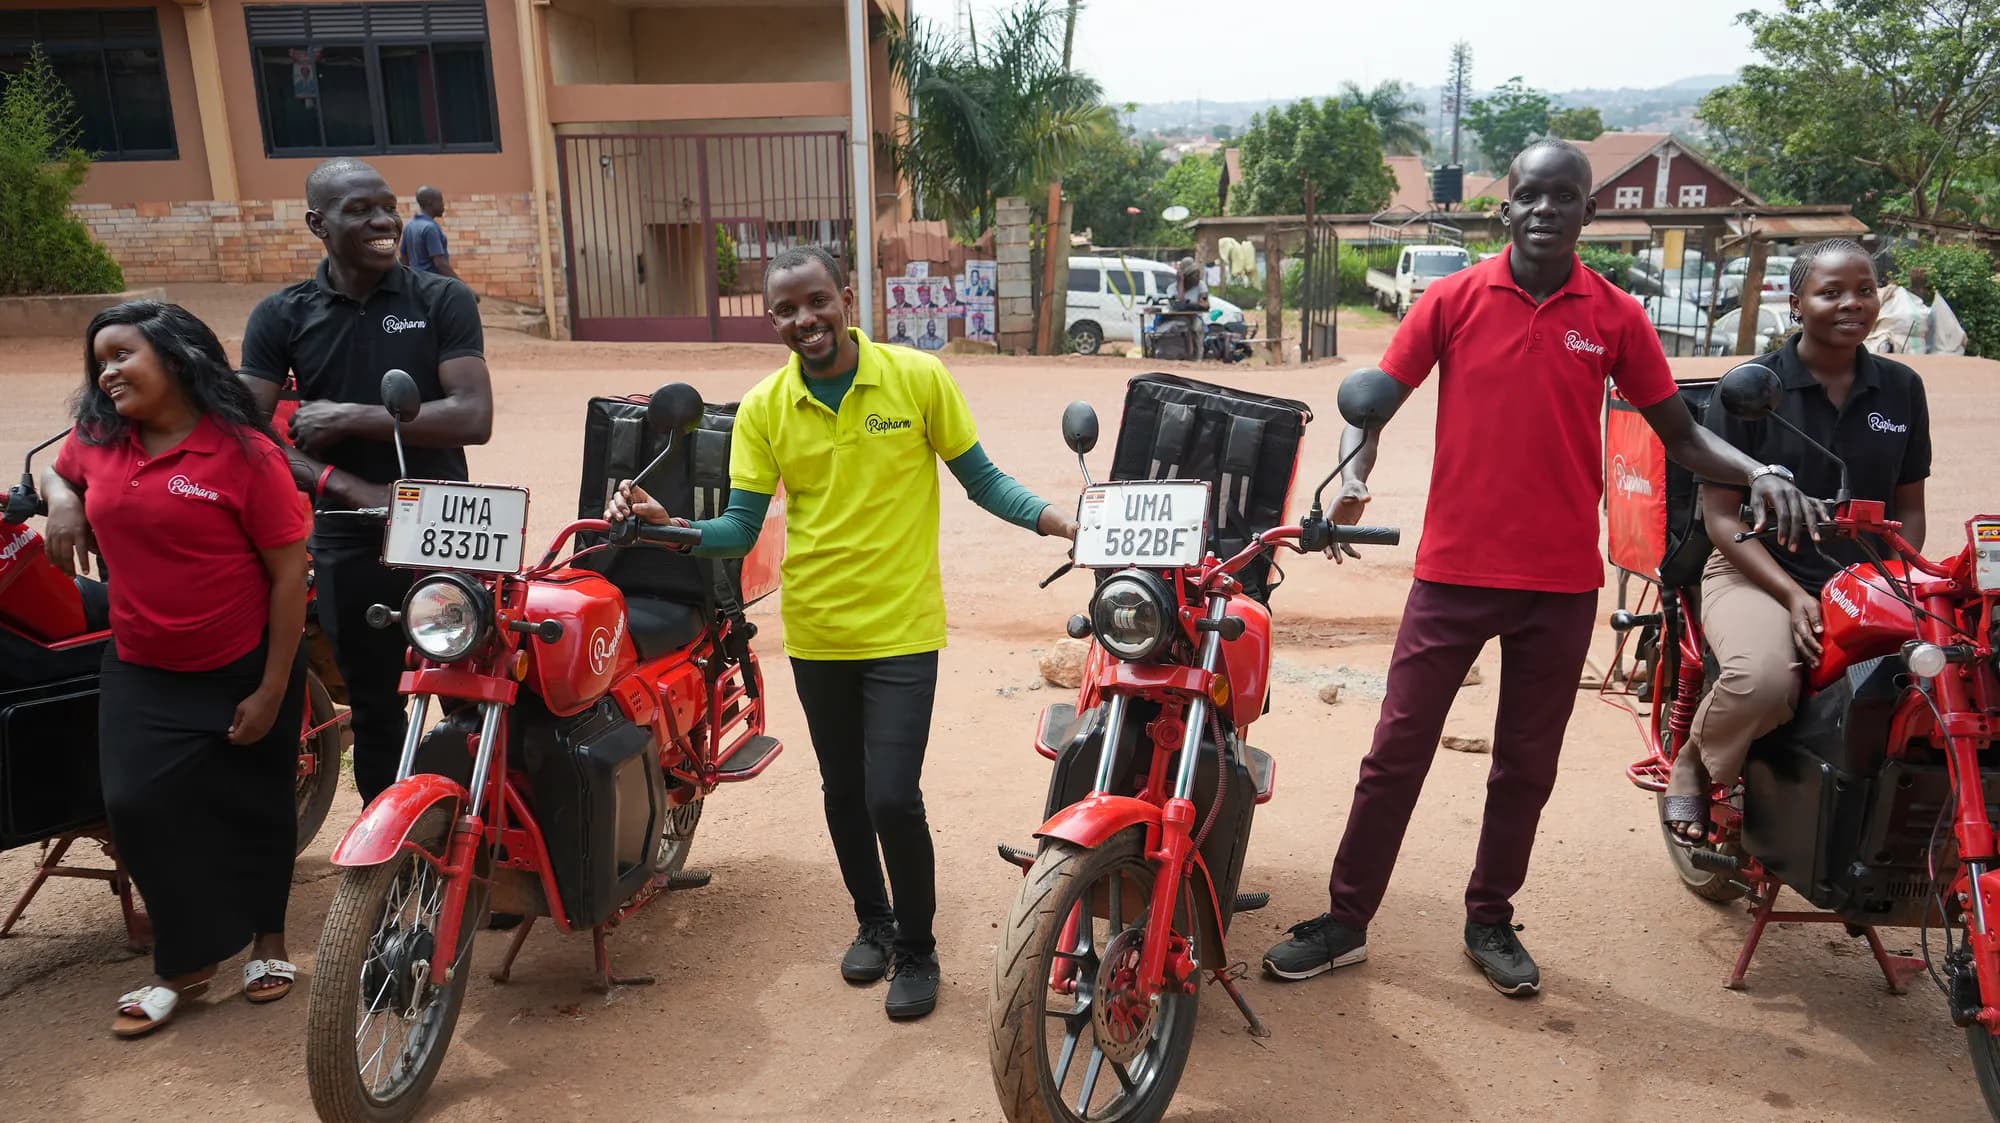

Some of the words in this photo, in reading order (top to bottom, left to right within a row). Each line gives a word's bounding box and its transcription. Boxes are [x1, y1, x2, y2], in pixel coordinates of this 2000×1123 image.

[382, 314, 427, 334] Rapharm
[1564, 329, 1605, 355] Rapharm
[864, 413, 912, 434] Rapharm
[1867, 412, 1908, 433] Rapharm
[167, 474, 220, 501] Rapharm
[441, 494, 491, 526] UMA
[1124, 493, 1172, 521] UMA
[420, 528, 509, 563] 833DT
[1104, 527, 1189, 556] 582BF
